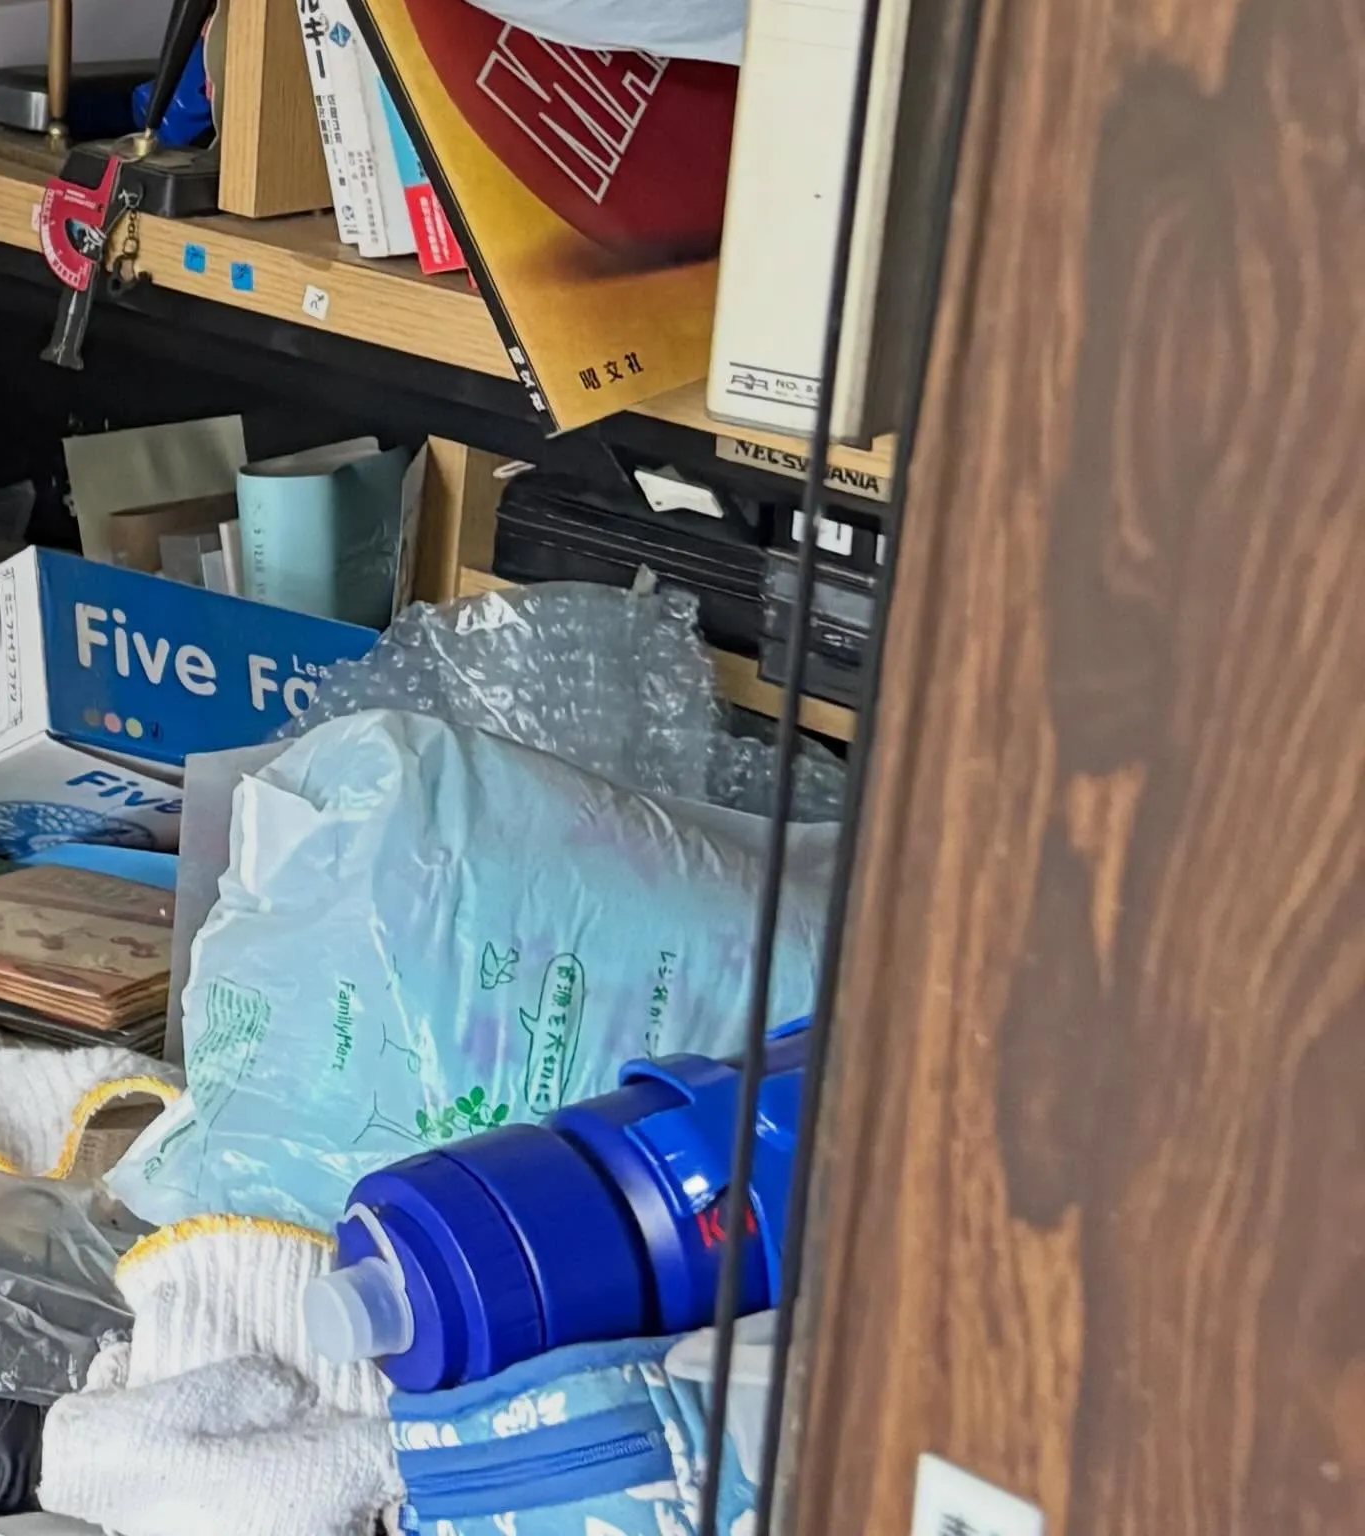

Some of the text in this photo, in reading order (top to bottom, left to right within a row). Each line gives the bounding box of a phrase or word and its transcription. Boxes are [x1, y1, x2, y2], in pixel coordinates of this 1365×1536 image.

[476, 20, 671, 206] MA
[578, 350, 646, 392] 昭文社
[781, 452, 882, 496] SYANIA
[74, 601, 218, 697] Five
[330, 980, 358, 1073] FamilyMart
